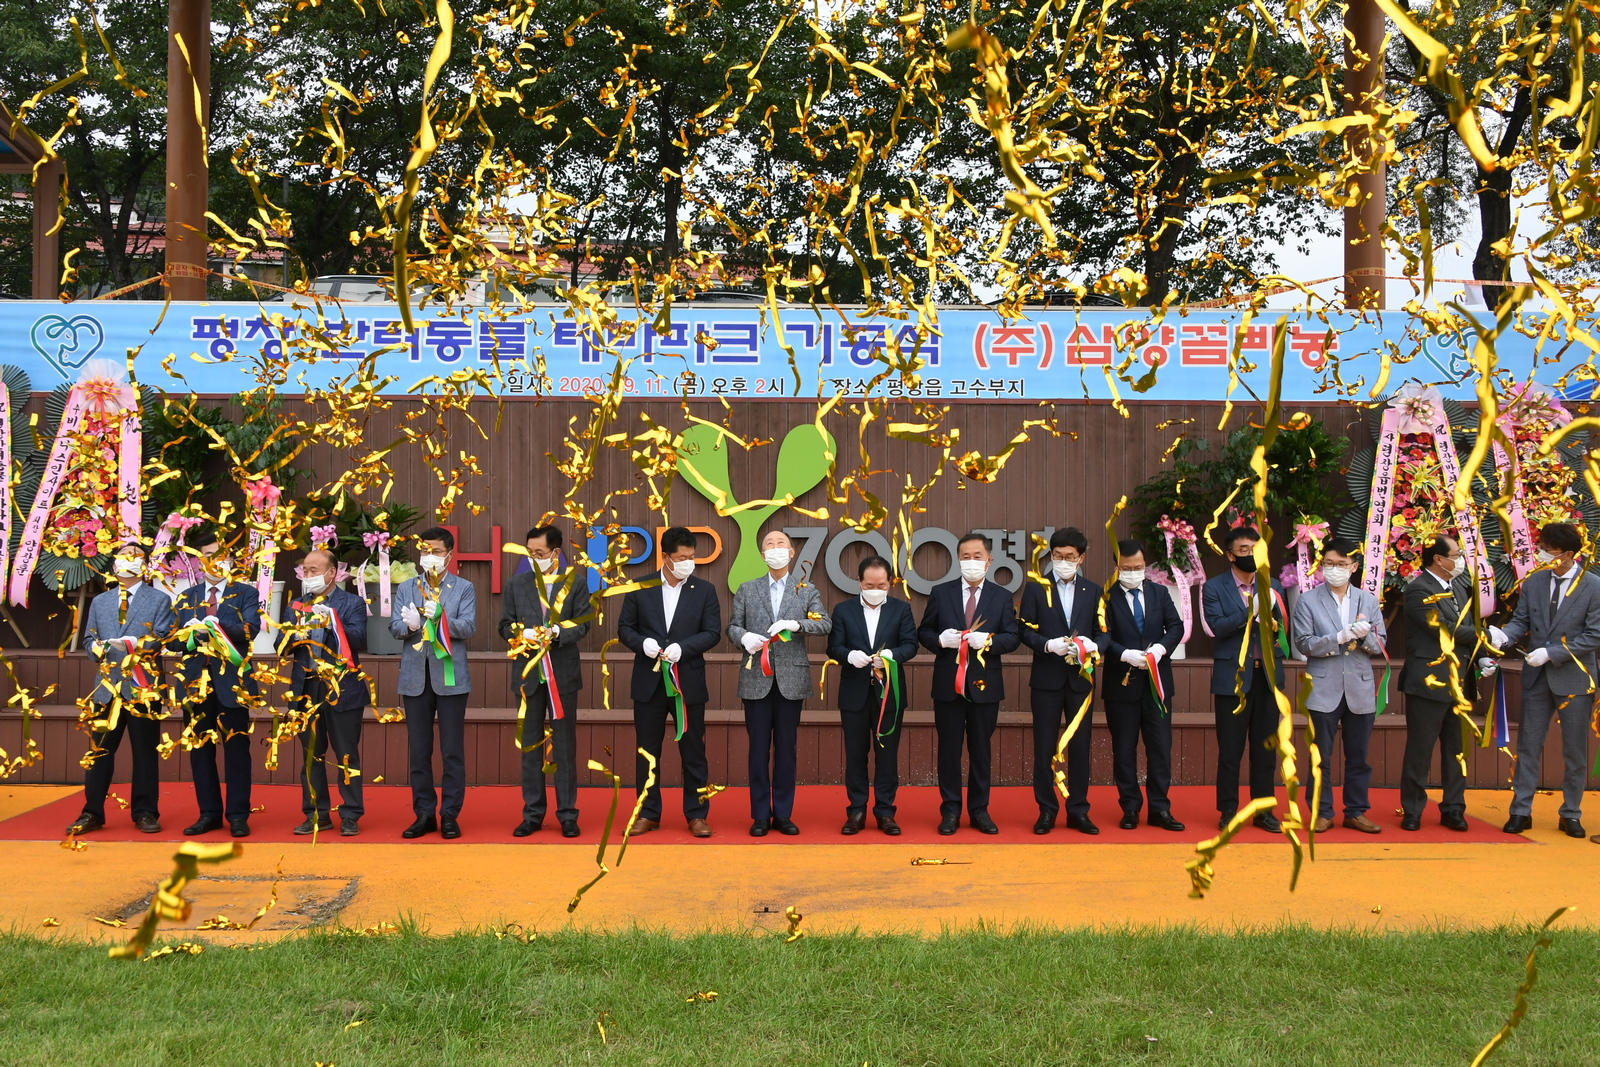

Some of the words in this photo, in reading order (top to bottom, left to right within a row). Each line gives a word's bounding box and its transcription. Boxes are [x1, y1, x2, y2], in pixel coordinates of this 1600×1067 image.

[192, 317, 295, 360] 평창
[321, 319, 526, 363] 반려동물
[553, 322, 759, 364] 테마파크
[785, 323, 939, 367] 기공식
[711, 377, 748, 396] 오후
[754, 378, 785, 395] 2시
[949, 379, 1024, 397] 고수부지
[1365, 564, 1379, 597] 지영
